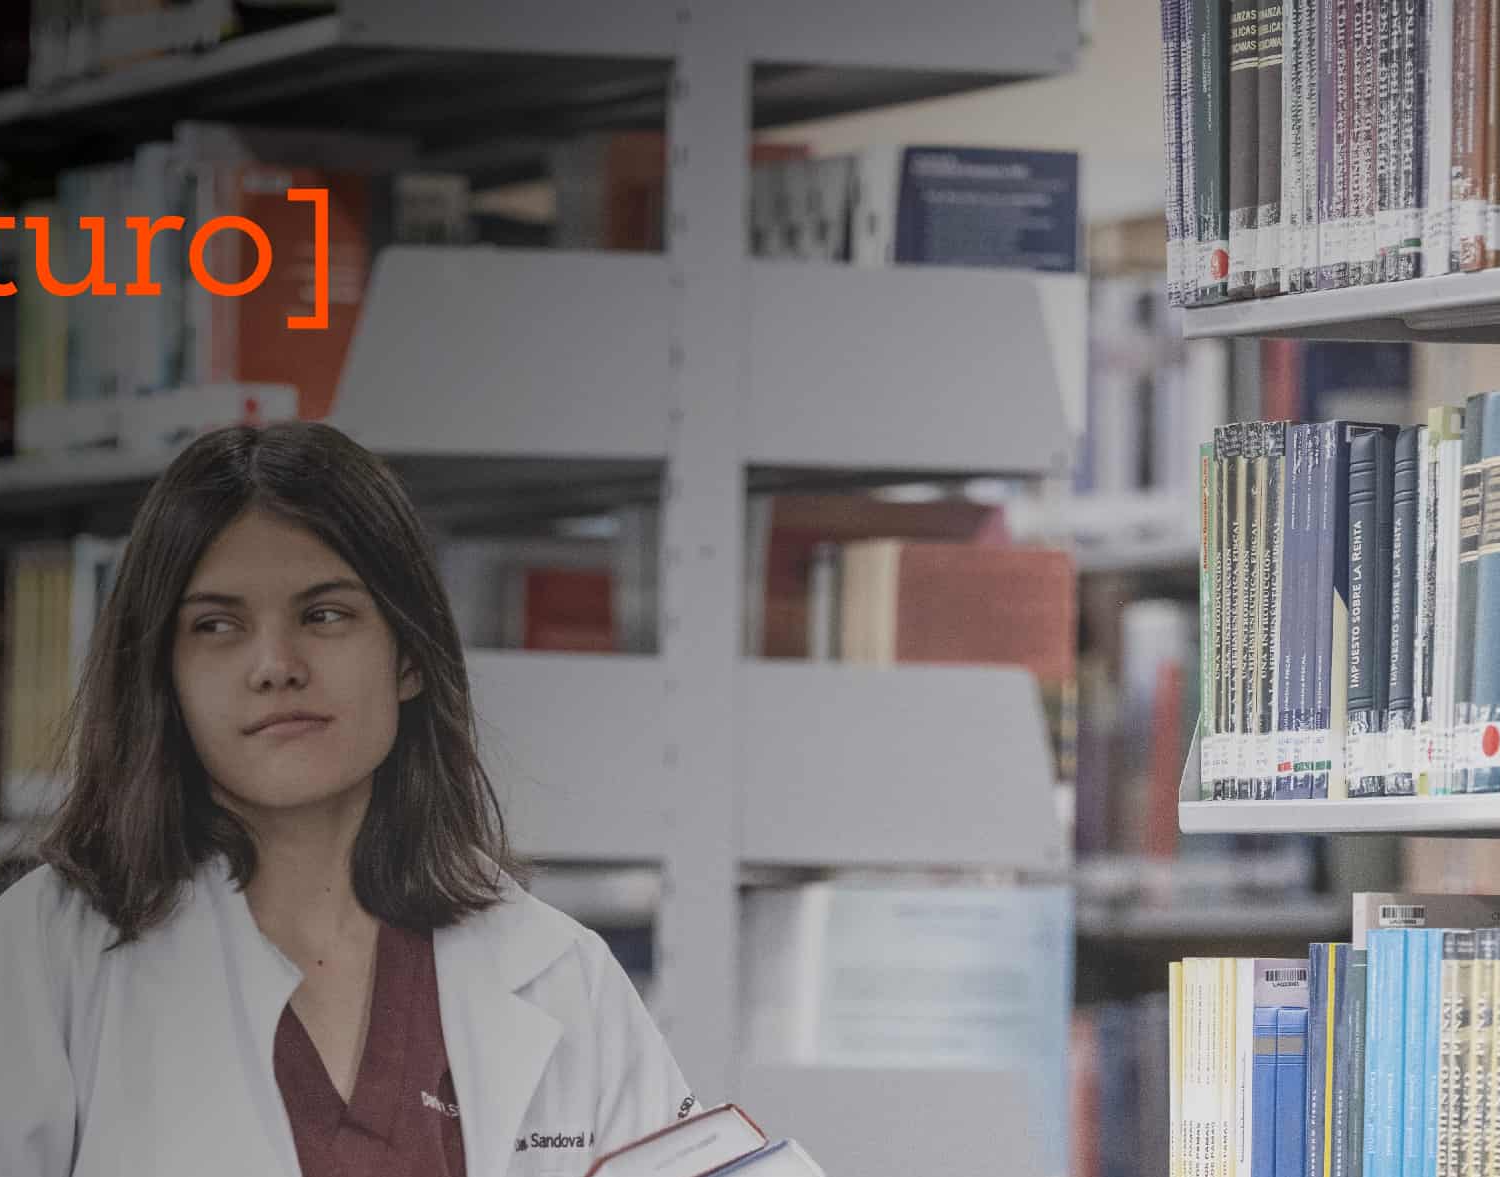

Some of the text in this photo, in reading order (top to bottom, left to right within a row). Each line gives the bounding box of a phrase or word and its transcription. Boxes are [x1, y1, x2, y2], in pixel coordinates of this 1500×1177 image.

[1350, 521, 1363, 688] IMPUESTO SOBRE LA RENTA
[1390, 518, 1402, 687] IMPUESTO SOBRE LA RENTA
[531, 1132, 585, 1148] Sandoval
